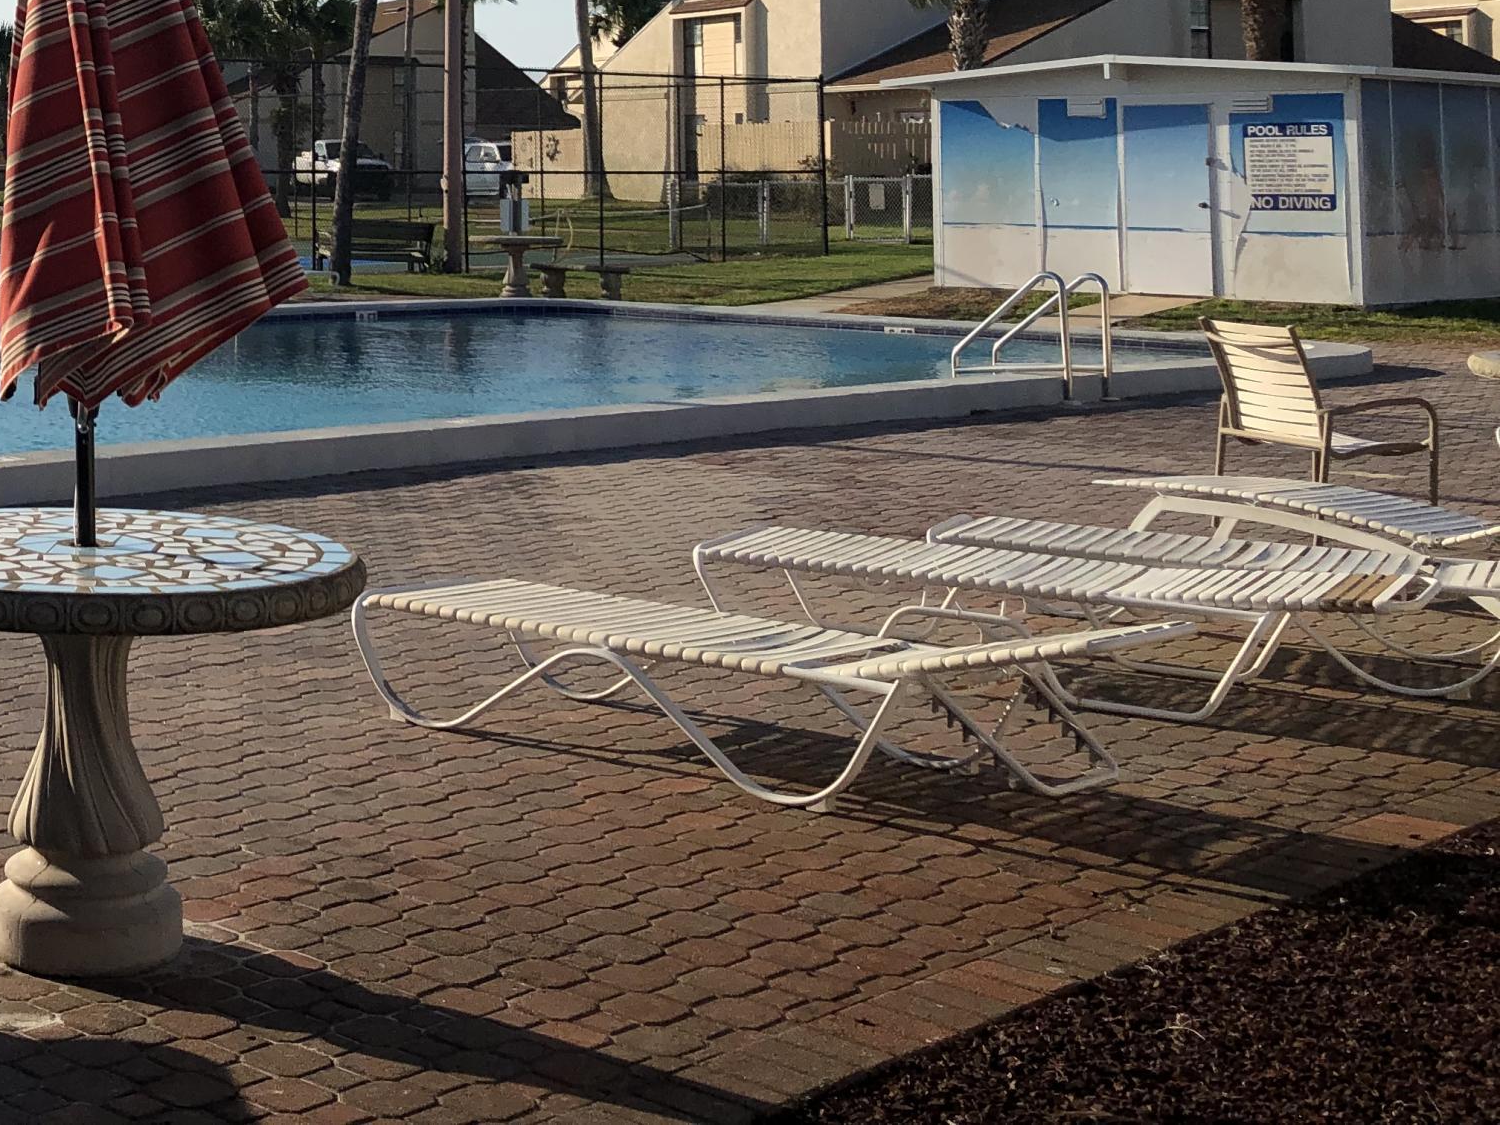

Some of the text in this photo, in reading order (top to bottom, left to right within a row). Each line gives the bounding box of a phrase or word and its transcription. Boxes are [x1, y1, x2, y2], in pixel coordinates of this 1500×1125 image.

[1247, 124, 1328, 136] POOL RULES
[1251, 196, 1332, 209] NO DIVING
